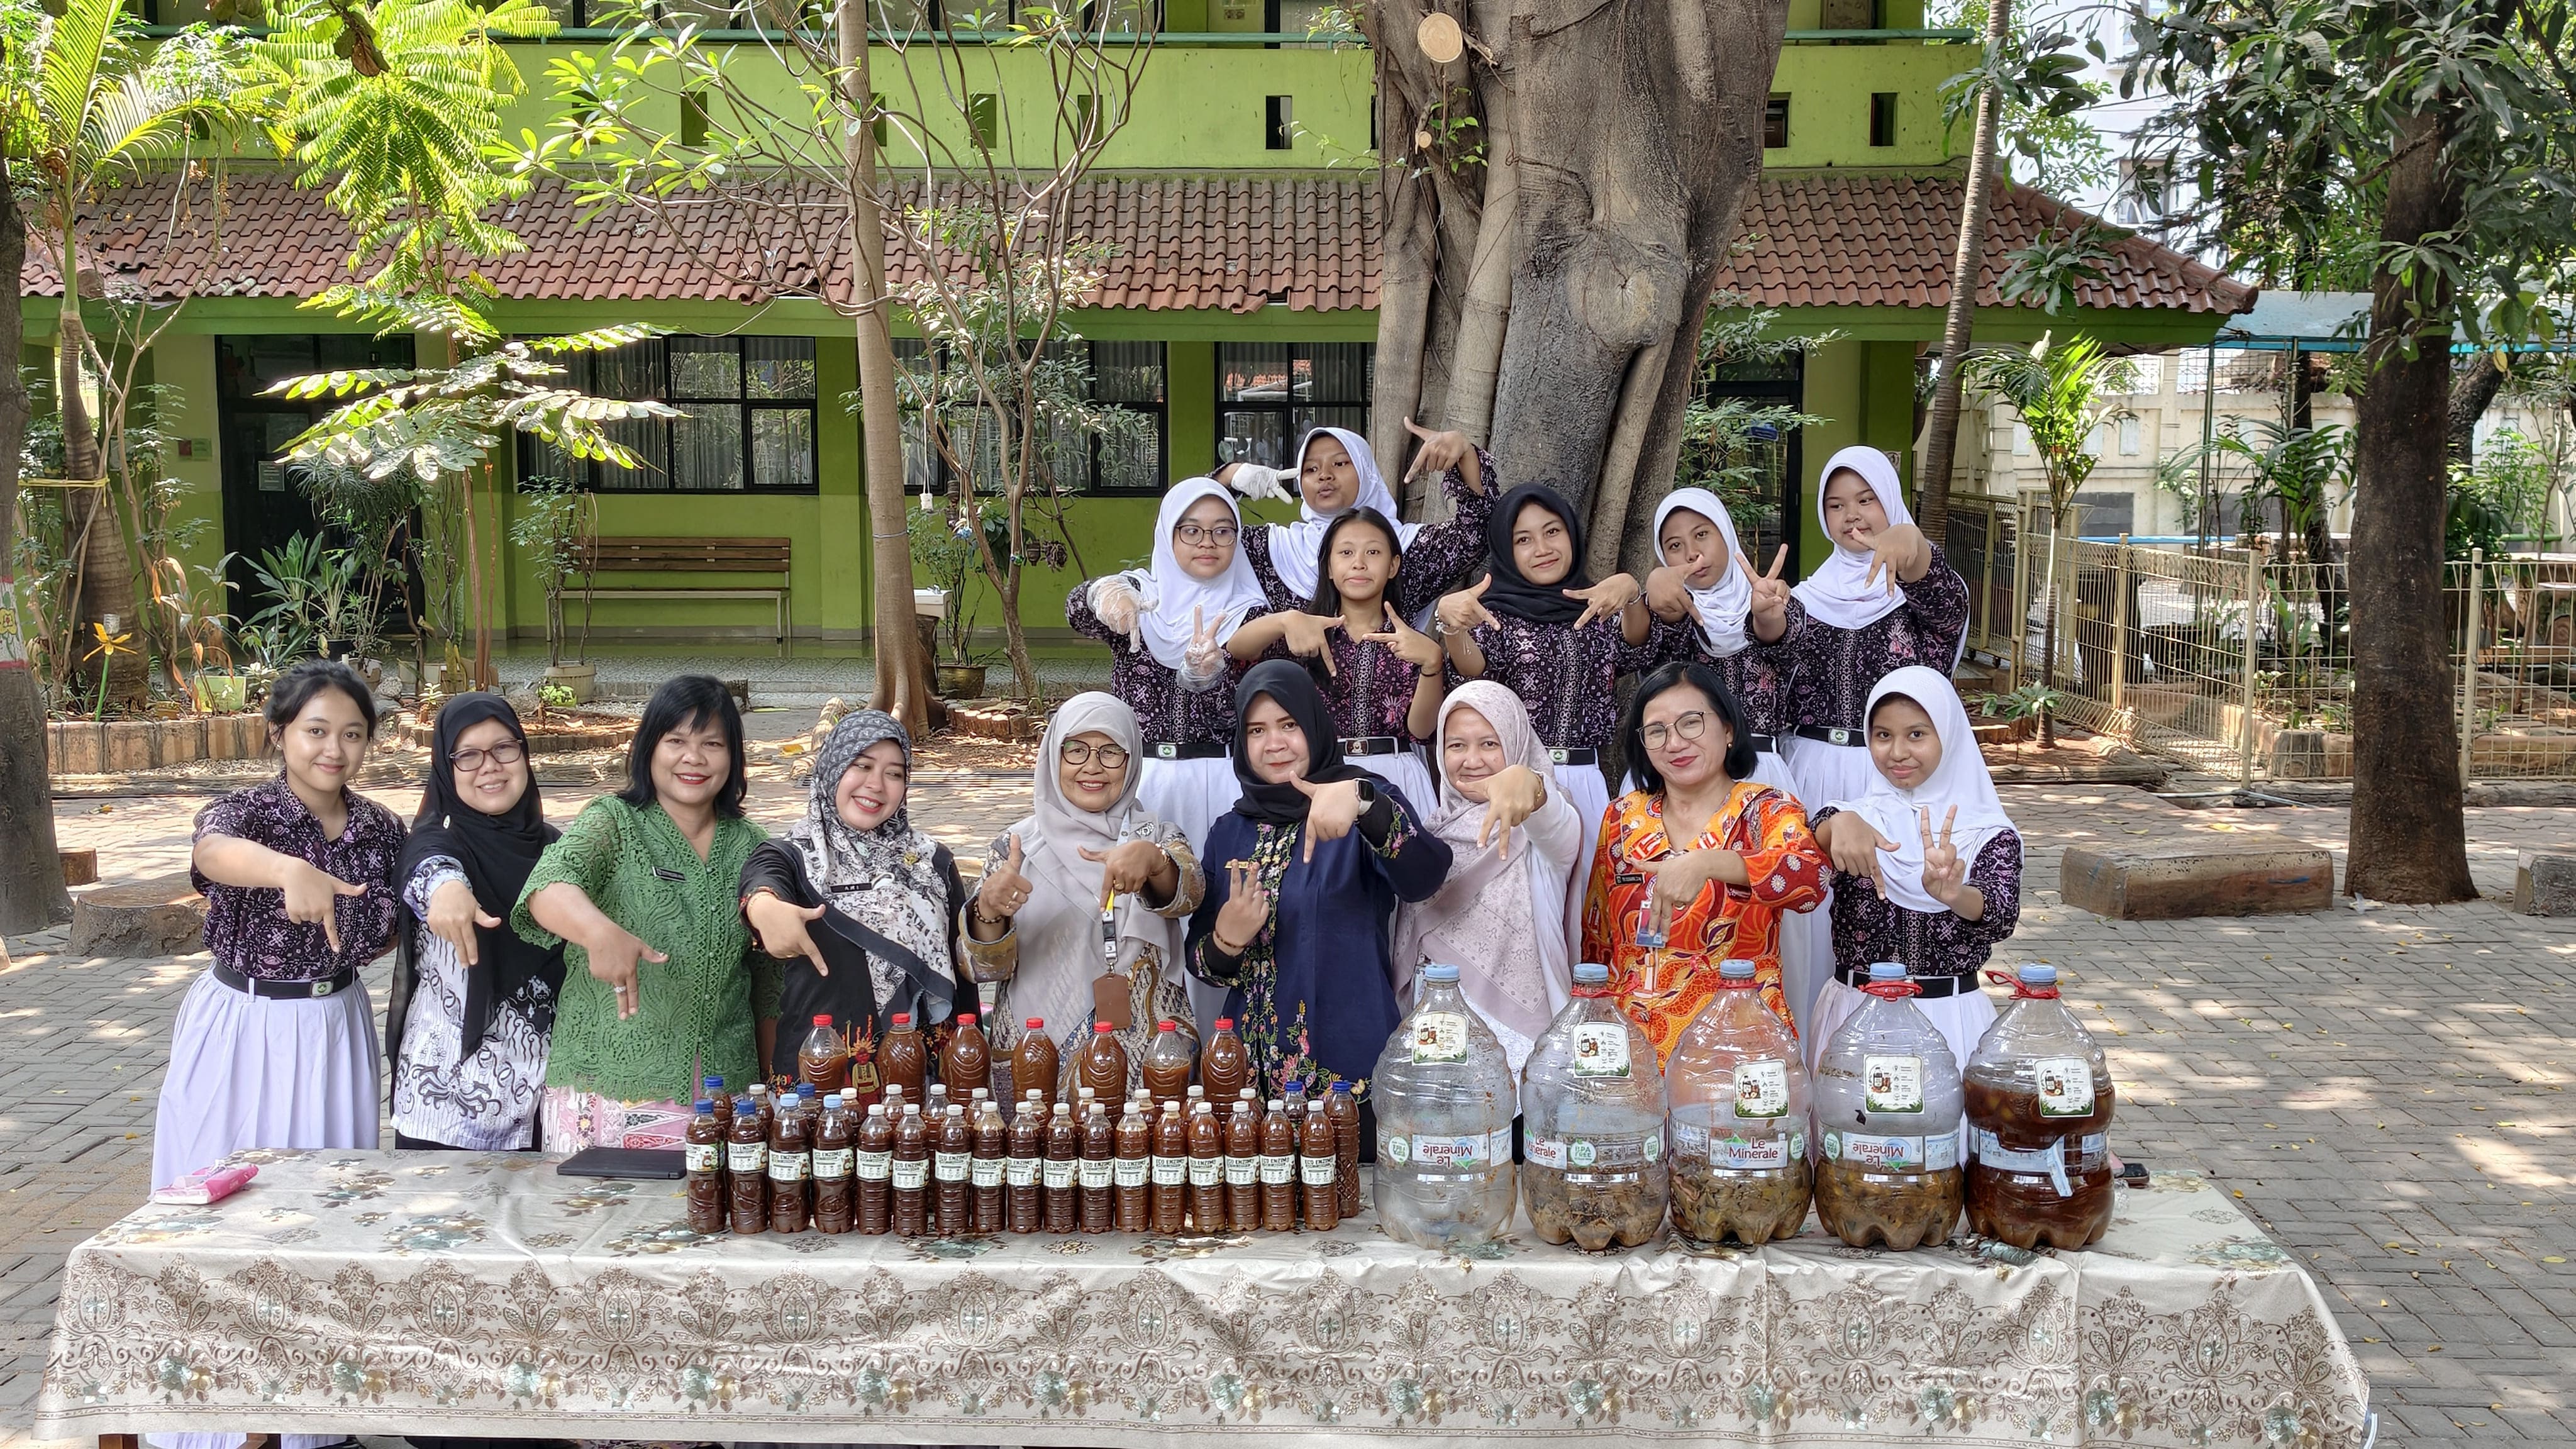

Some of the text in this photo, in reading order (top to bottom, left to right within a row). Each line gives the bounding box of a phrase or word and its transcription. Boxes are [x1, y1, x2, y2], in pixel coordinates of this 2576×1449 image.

[1535, 1133, 1545, 1146] Le
[1751, 1138, 1765, 1149] Le
[1423, 1145, 1473, 1156] Minerale
[1729, 1147, 1779, 1159] Minerale
[1853, 1143, 1904, 1158] Minerale
[1436, 1155, 1451, 1168] Le
[1866, 1155, 1881, 1168] Le
